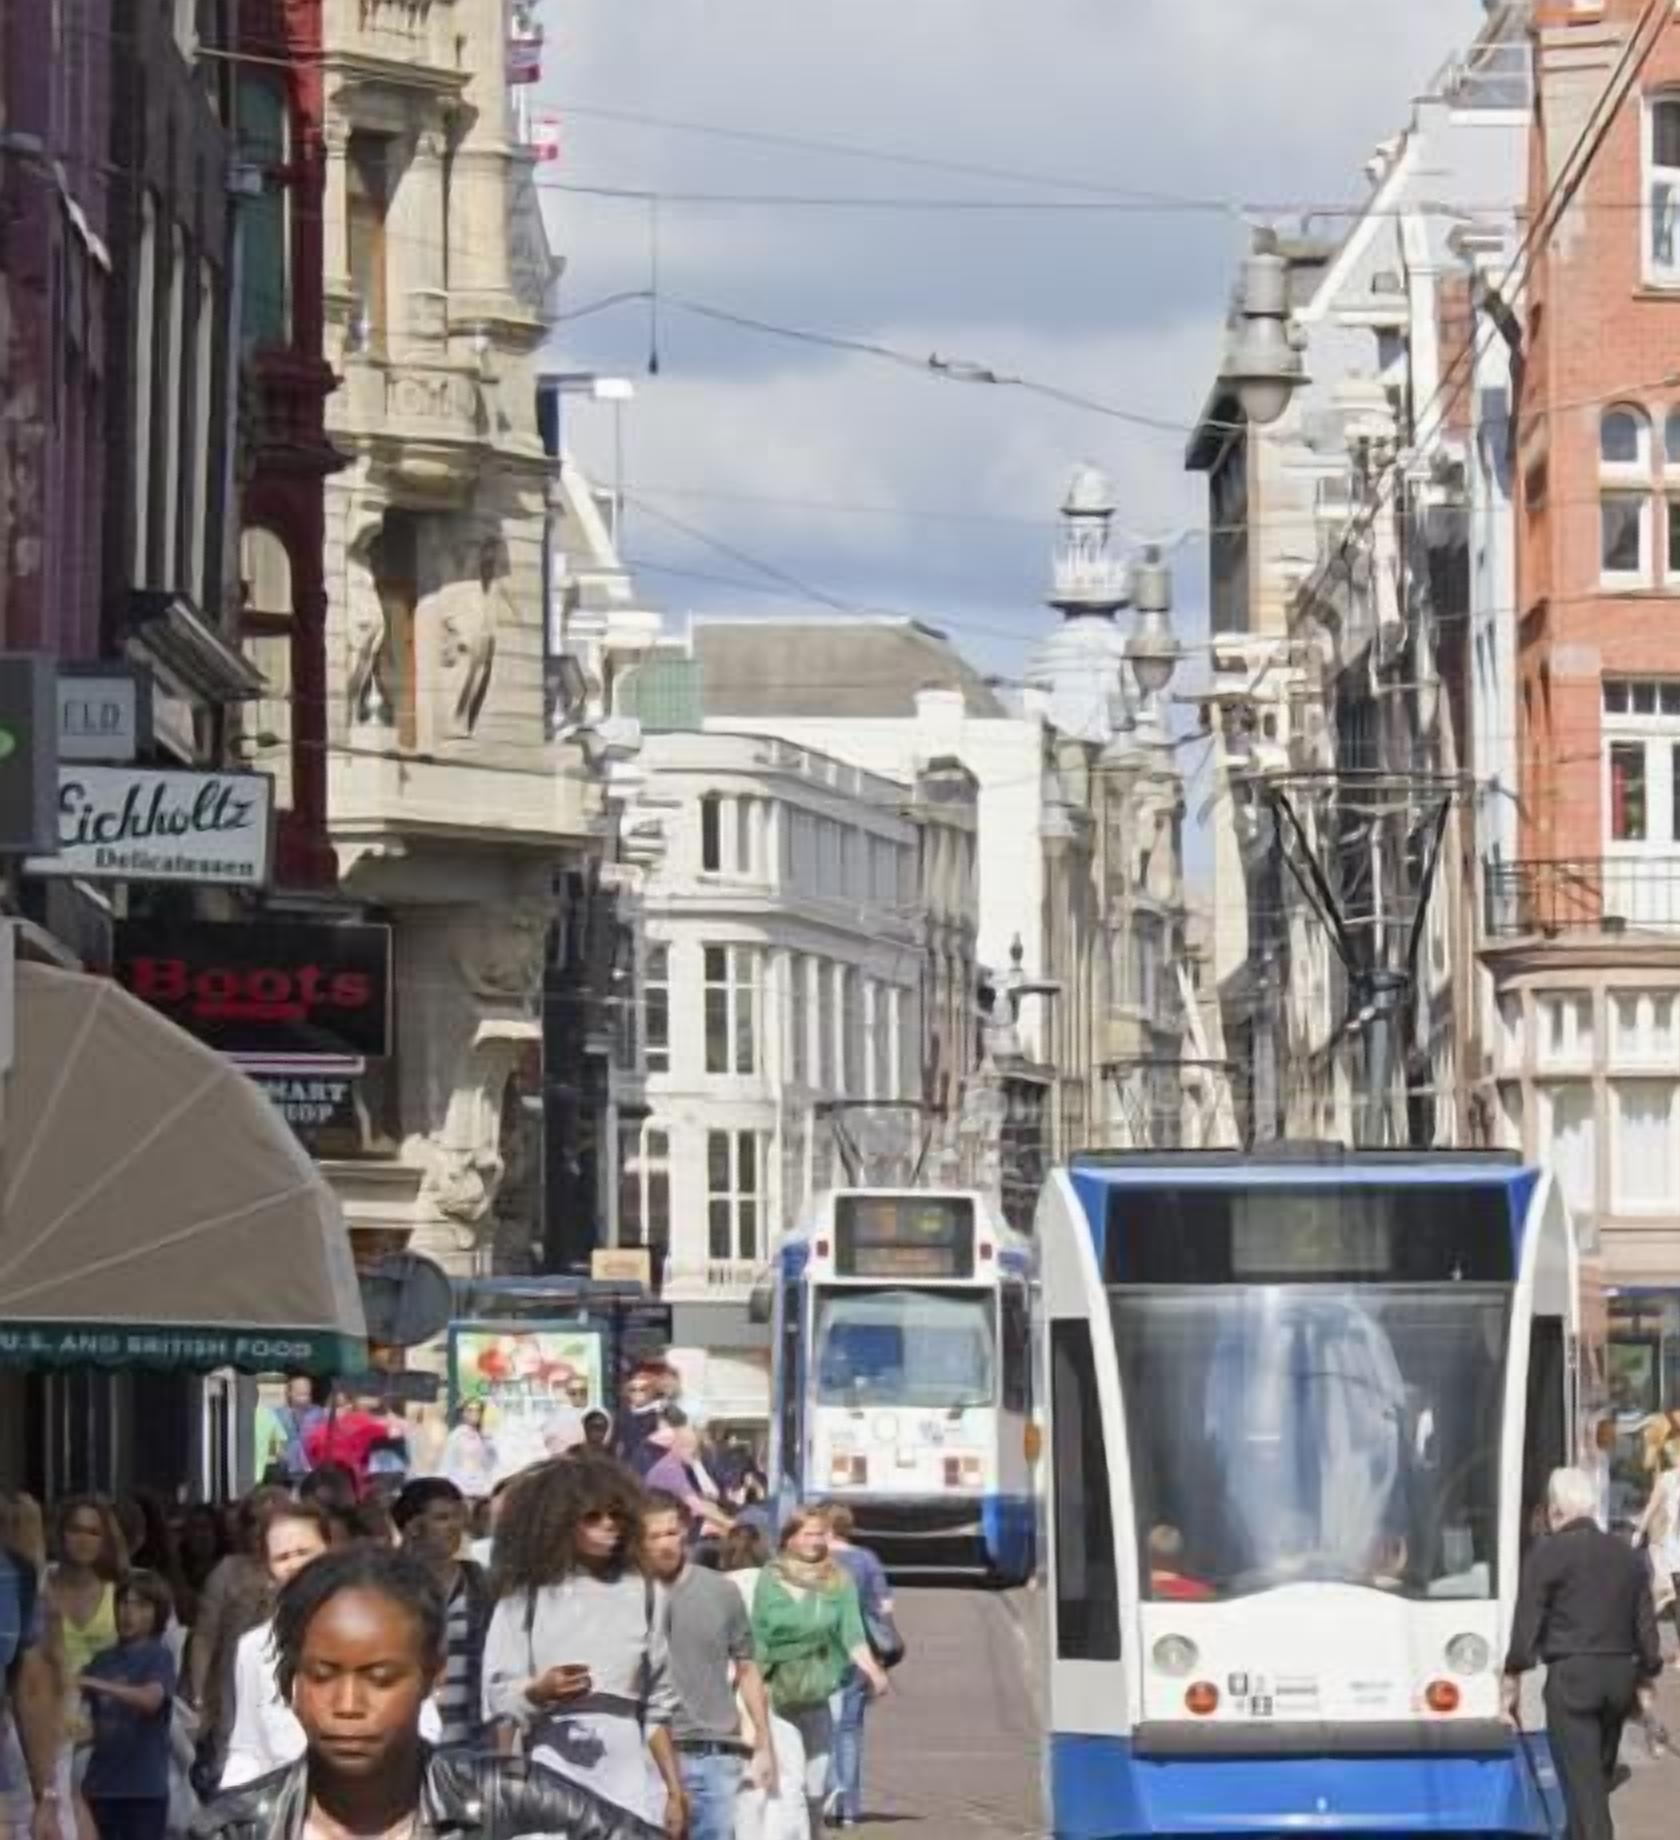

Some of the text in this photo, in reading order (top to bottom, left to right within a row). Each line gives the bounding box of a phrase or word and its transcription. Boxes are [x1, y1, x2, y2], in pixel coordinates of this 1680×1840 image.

[59, 780, 258, 849] Eichholtz
[95, 848, 255, 877] Delicatessen
[131, 957, 370, 1012] Boots
[266, 1080, 348, 1102] MART
[285, 1103, 333, 1122] HOP
